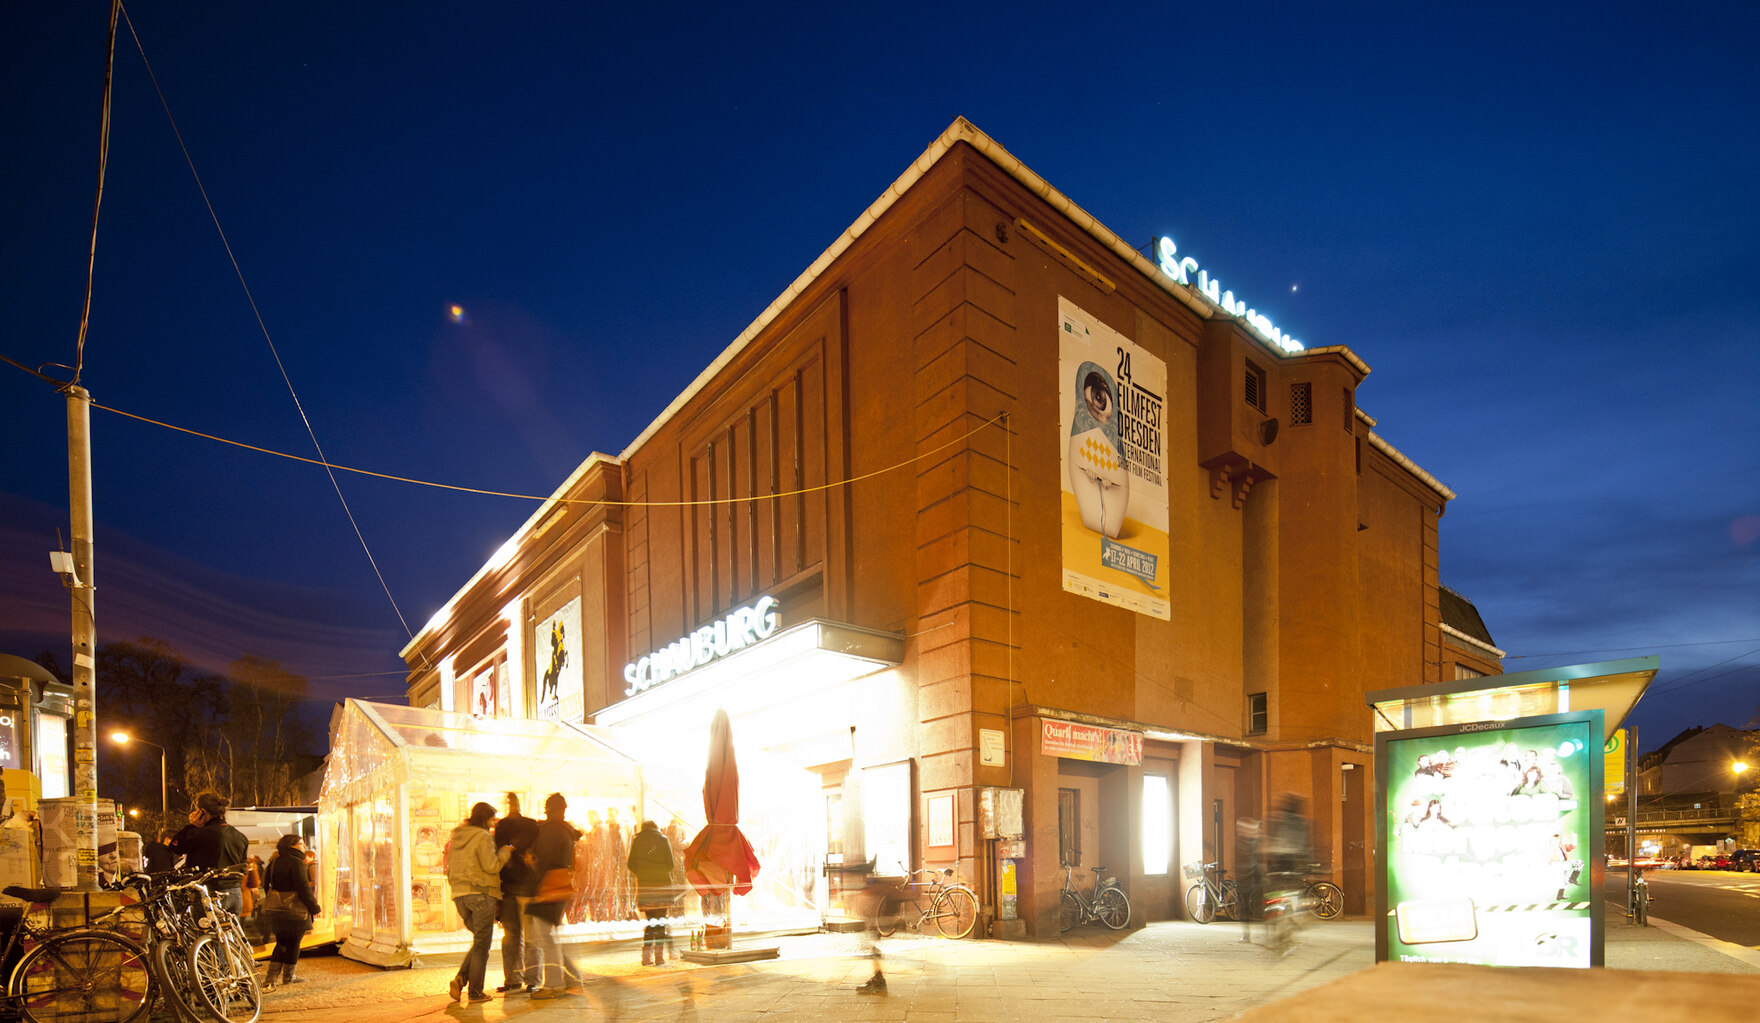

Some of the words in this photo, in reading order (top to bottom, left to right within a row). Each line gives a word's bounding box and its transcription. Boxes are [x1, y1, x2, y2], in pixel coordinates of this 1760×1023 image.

[1117, 347, 1131, 384] 24
[1117, 382, 1162, 430] FILMFEST
[1117, 411, 1161, 457] DRESDEN
[1117, 438, 1161, 474] INTERNATIONAL
[1132, 462, 1143, 478] FILM
[1144, 468, 1162, 487] FESTIVAL
[1127, 555, 1141, 572] APRIL
[1142, 560, 1155, 576] 2012
[624, 595, 782, 697] SCHAUBURG
[1459, 721, 1505, 733] JCDecaux
